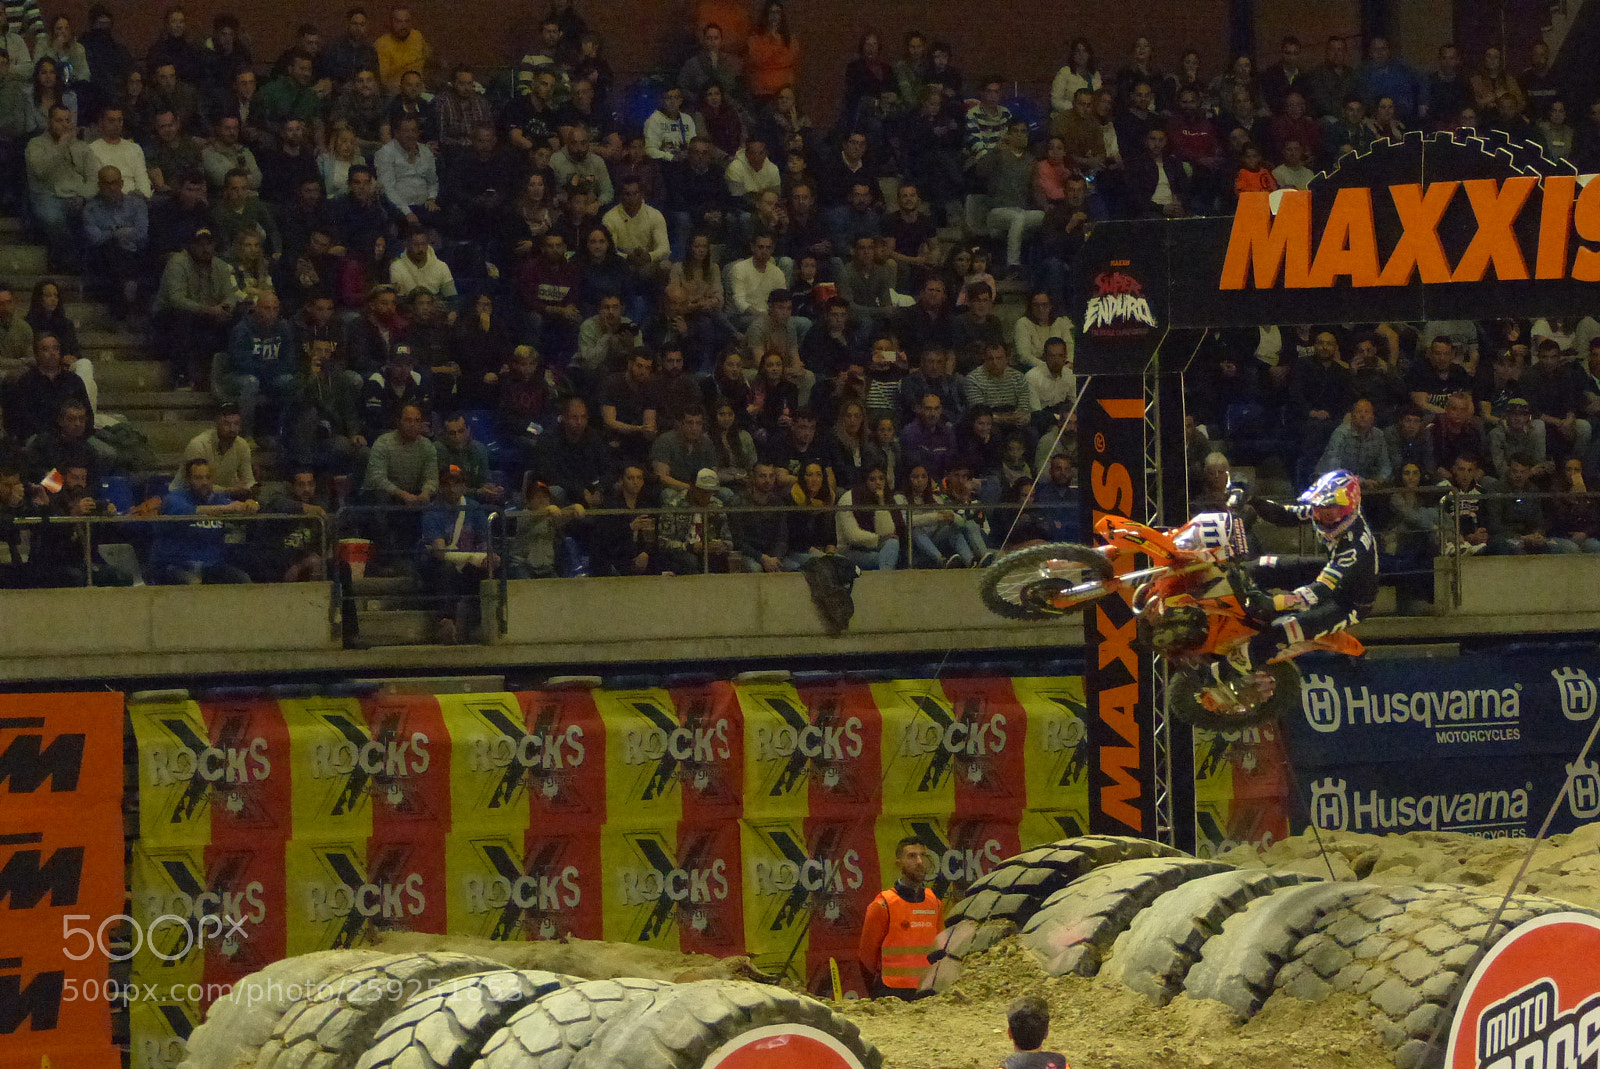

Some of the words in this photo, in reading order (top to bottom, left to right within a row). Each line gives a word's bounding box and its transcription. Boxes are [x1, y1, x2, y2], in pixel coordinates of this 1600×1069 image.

[1083, 293, 1158, 334] ENDURO
[1201, 521, 1221, 548] 111
[1345, 685, 1520, 728] Husqvarna
[311, 732, 430, 779] ROCKS
[470, 725, 585, 772] ROCKS
[625, 719, 731, 765] ROCKS
[757, 717, 863, 761] ROCKS
[902, 714, 1007, 757] ROCKS
[1436, 728, 1521, 744] MOTORCYCLES
[151, 737, 271, 786] ROCKS
[1354, 788, 1529, 831] Husqvarna
[623, 858, 729, 906] ROCKS
[755, 850, 863, 896] ROCKS
[925, 839, 1000, 882] OCKS
[310, 873, 425, 922] ROCKS
[466, 865, 581, 914] ROCKS
[1486, 991, 1548, 1058] MOTO
